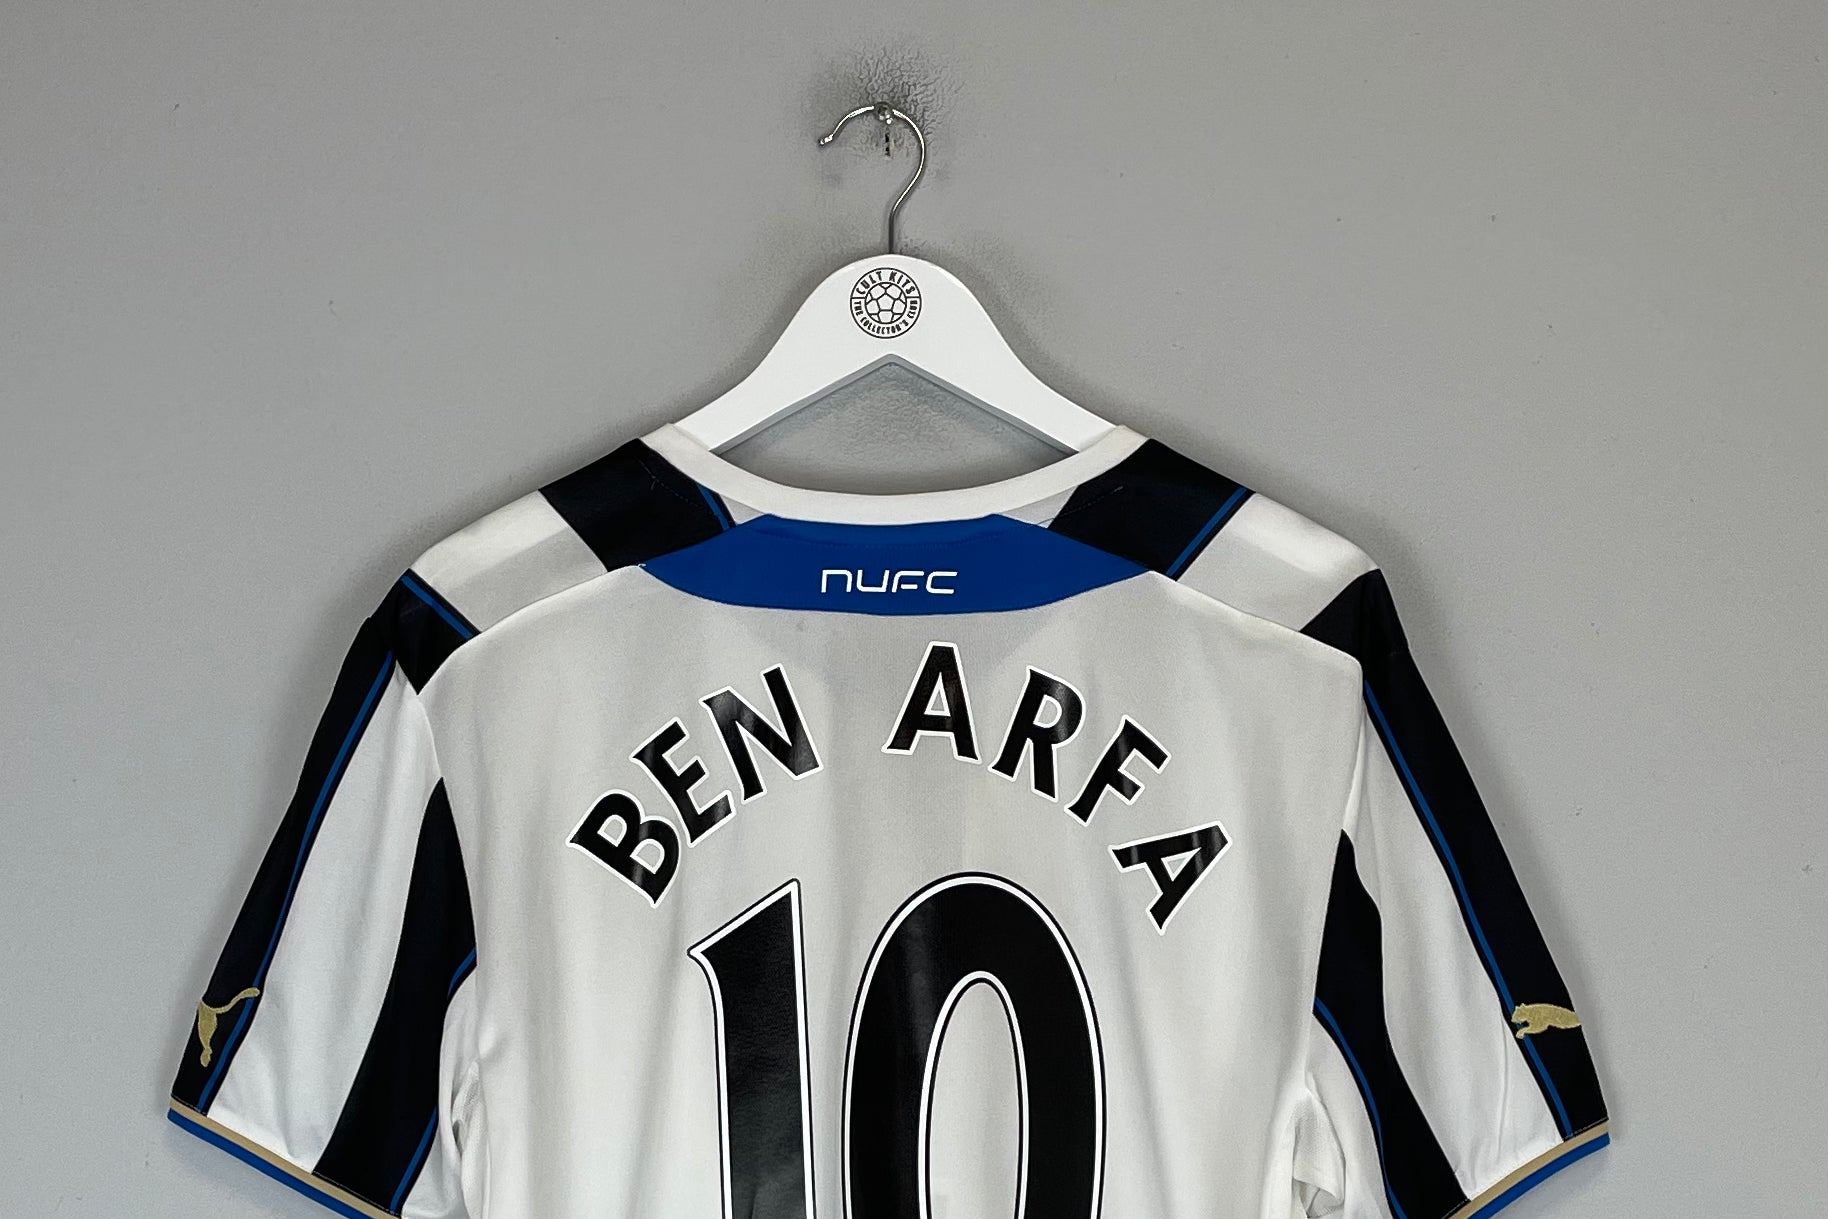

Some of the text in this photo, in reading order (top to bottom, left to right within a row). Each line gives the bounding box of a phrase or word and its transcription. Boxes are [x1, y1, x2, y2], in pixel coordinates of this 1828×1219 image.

[856, 271, 915, 294] CULT KITS
[854, 301, 863, 316] THE
[566, 641, 1233, 933] BEN ARFA
